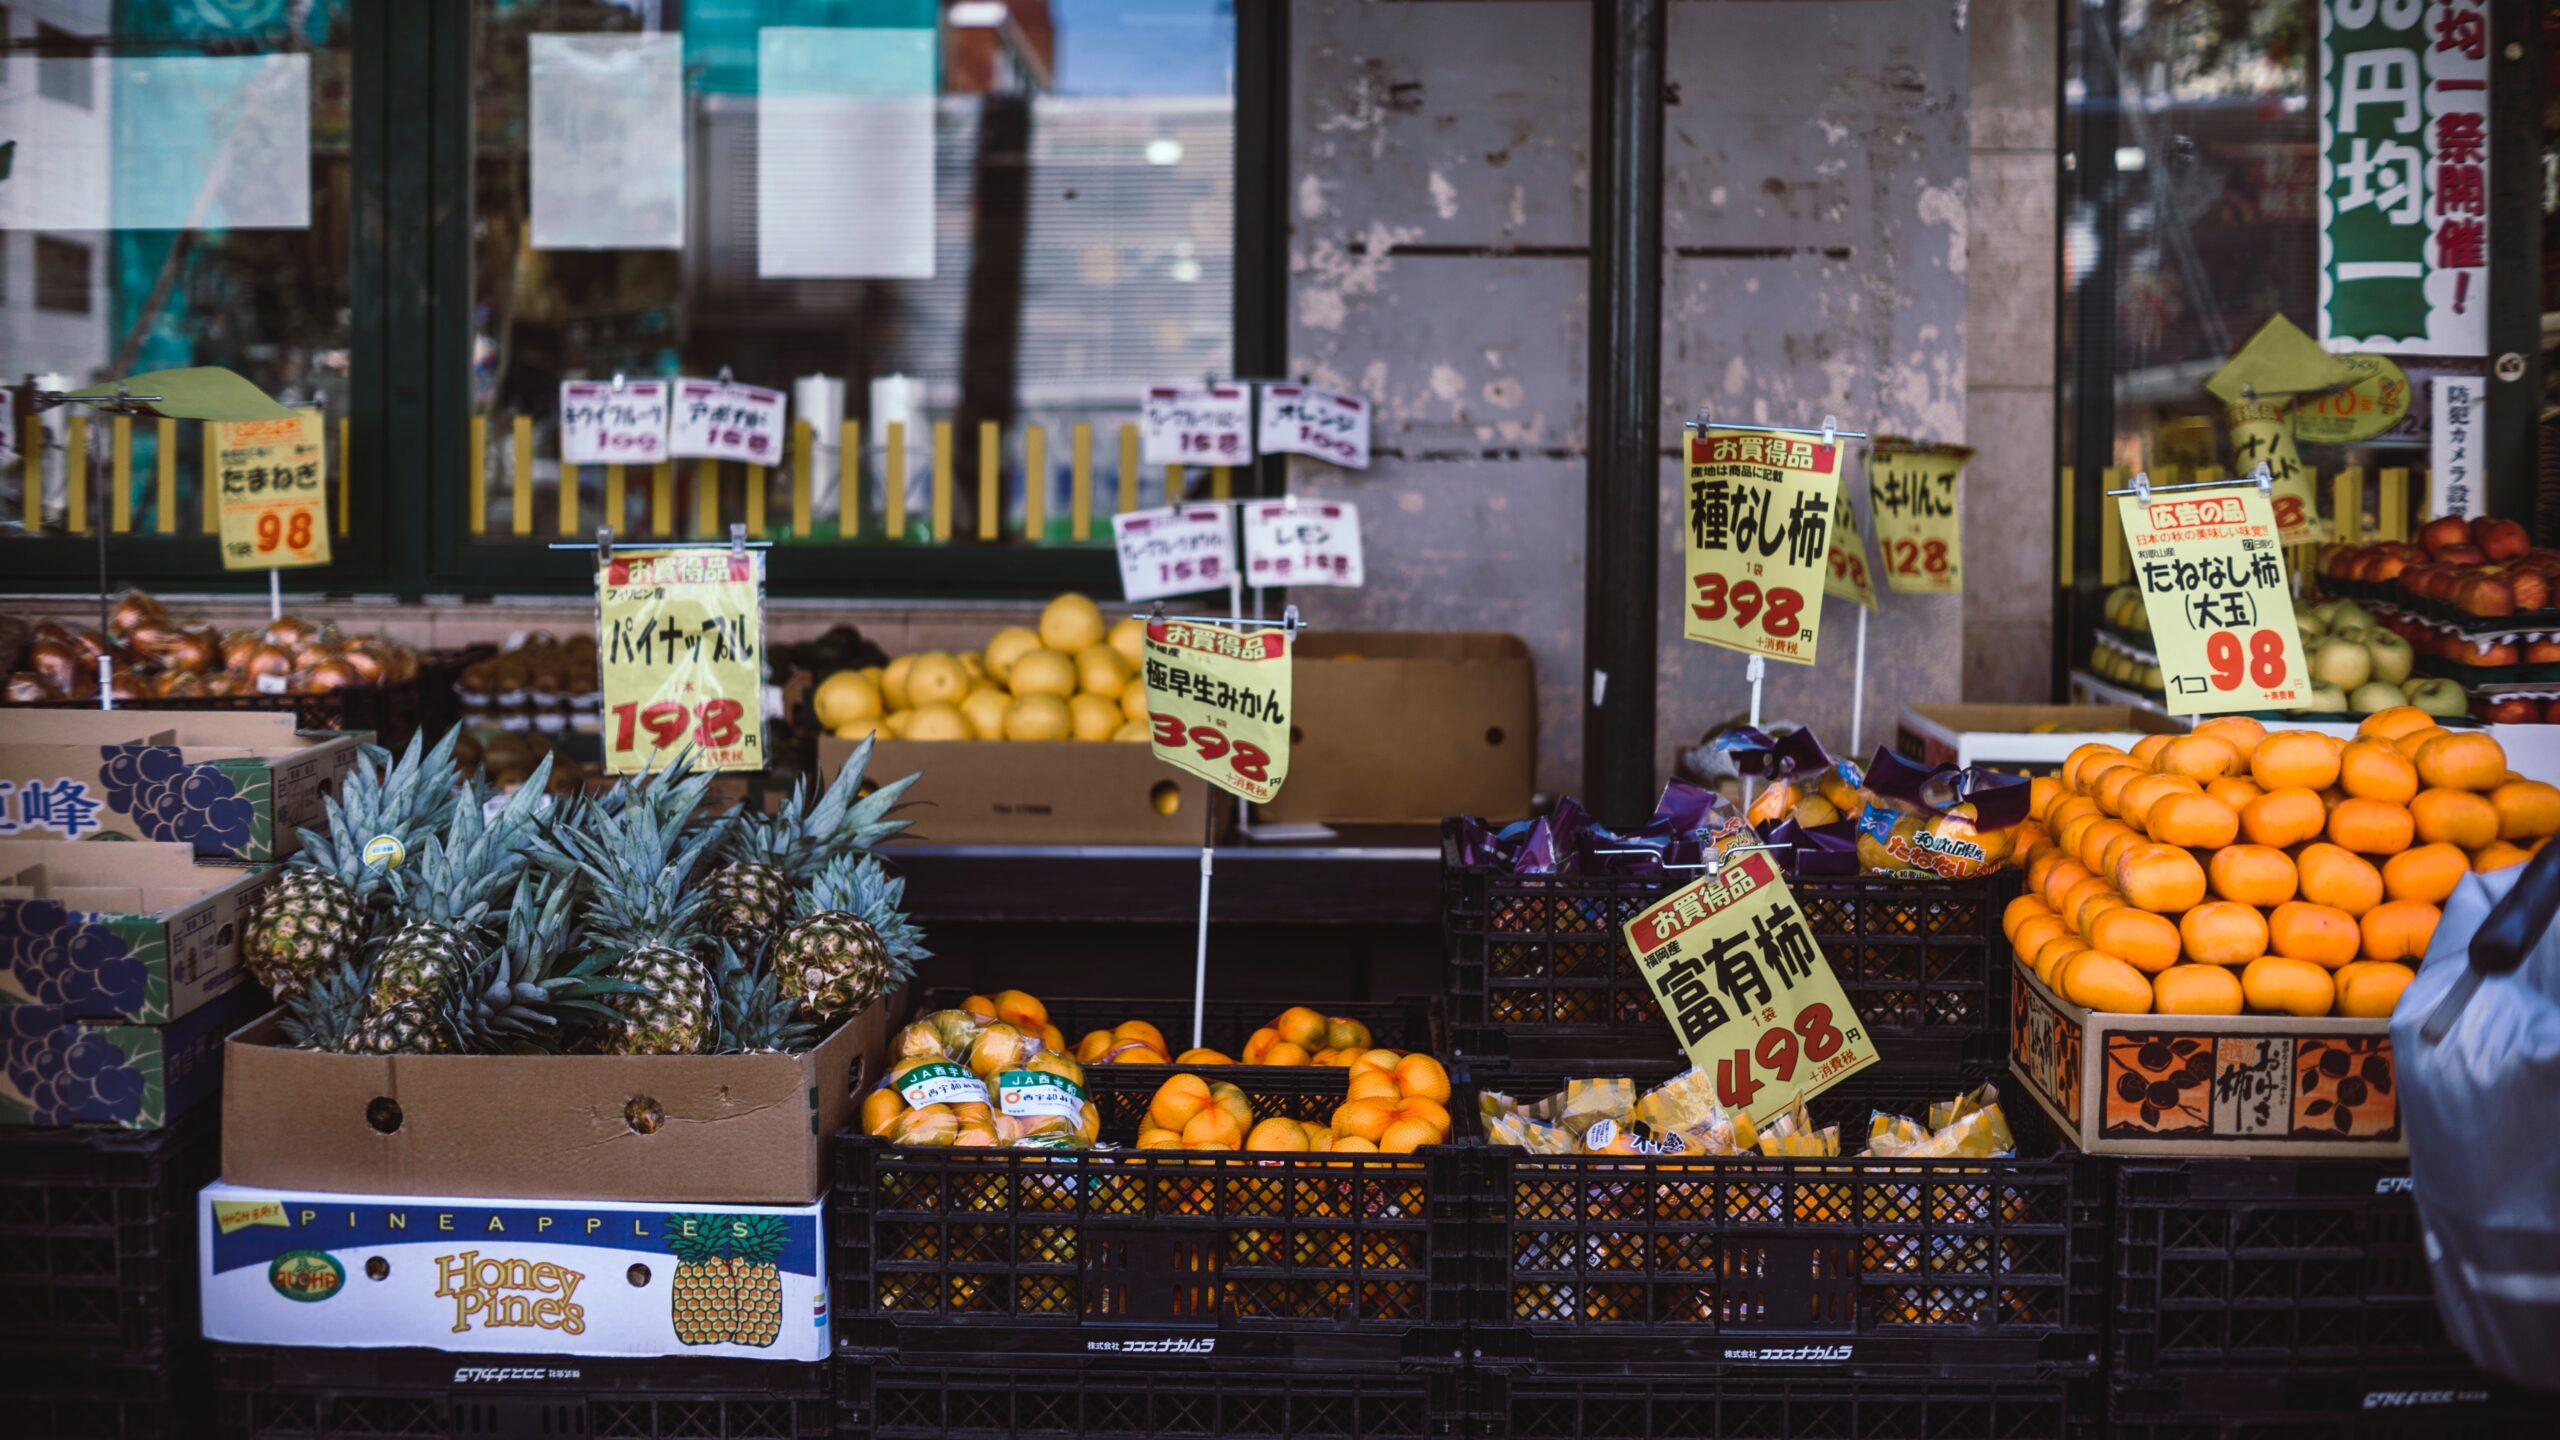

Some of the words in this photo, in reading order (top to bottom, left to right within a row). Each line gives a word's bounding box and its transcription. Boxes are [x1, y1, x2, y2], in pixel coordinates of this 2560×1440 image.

[2434, 0, 2487, 315] 均一祭開催!
[1713, 436, 1814, 470] お買得品
[222, 461, 319, 494] たまねぎ
[1691, 464, 1784, 484] 産地は商品に記載
[256, 508, 314, 556] 98
[1690, 479, 1830, 569] 種なし柿
[2151, 498, 2247, 528] 広告の品
[628, 557, 731, 583] お買得品
[1881, 537, 1948, 577] 128
[2142, 552, 2281, 594] たねなし柿
[1691, 571, 1805, 639] 398
[1800, 628, 1813, 643] 円
[2185, 590, 2258, 631] (大玉)
[610, 614, 755, 666] パイナップル
[1165, 626, 1267, 661] お買得品
[1756, 636, 1799, 656] +消費税
[2206, 628, 2288, 692] 98
[1146, 657, 1286, 725] 極早生みかん
[611, 698, 744, 753] 198
[744, 733, 757, 748] 円
[1149, 710, 1271, 783] 398
[1269, 776, 1283, 788] 円
[1225, 772, 1269, 798] +消費税
[1651, 866, 1757, 941] お買得品
[1643, 940, 1683, 970] 福岡産
[1656, 902, 1816, 1047] 富有柿
[1716, 1002, 1845, 1110] 498
[1845, 1027, 1862, 1044] 円
[1809, 1048, 1858, 1084] +消費税
[301, 1210, 749, 1238] PINEAPPLES
[273, 1267, 340, 1292] ALOHA
[434, 1250, 586, 1305] Honey
[451, 1288, 587, 1336] Pines
[1087, 1340, 1120, 1351] 株式会社
[1121, 1338, 1215, 1353] ココスナカムラ
[1724, 1349, 1757, 1360] 株式会社
[1759, 1345, 1854, 1361] ココスナカムラ
